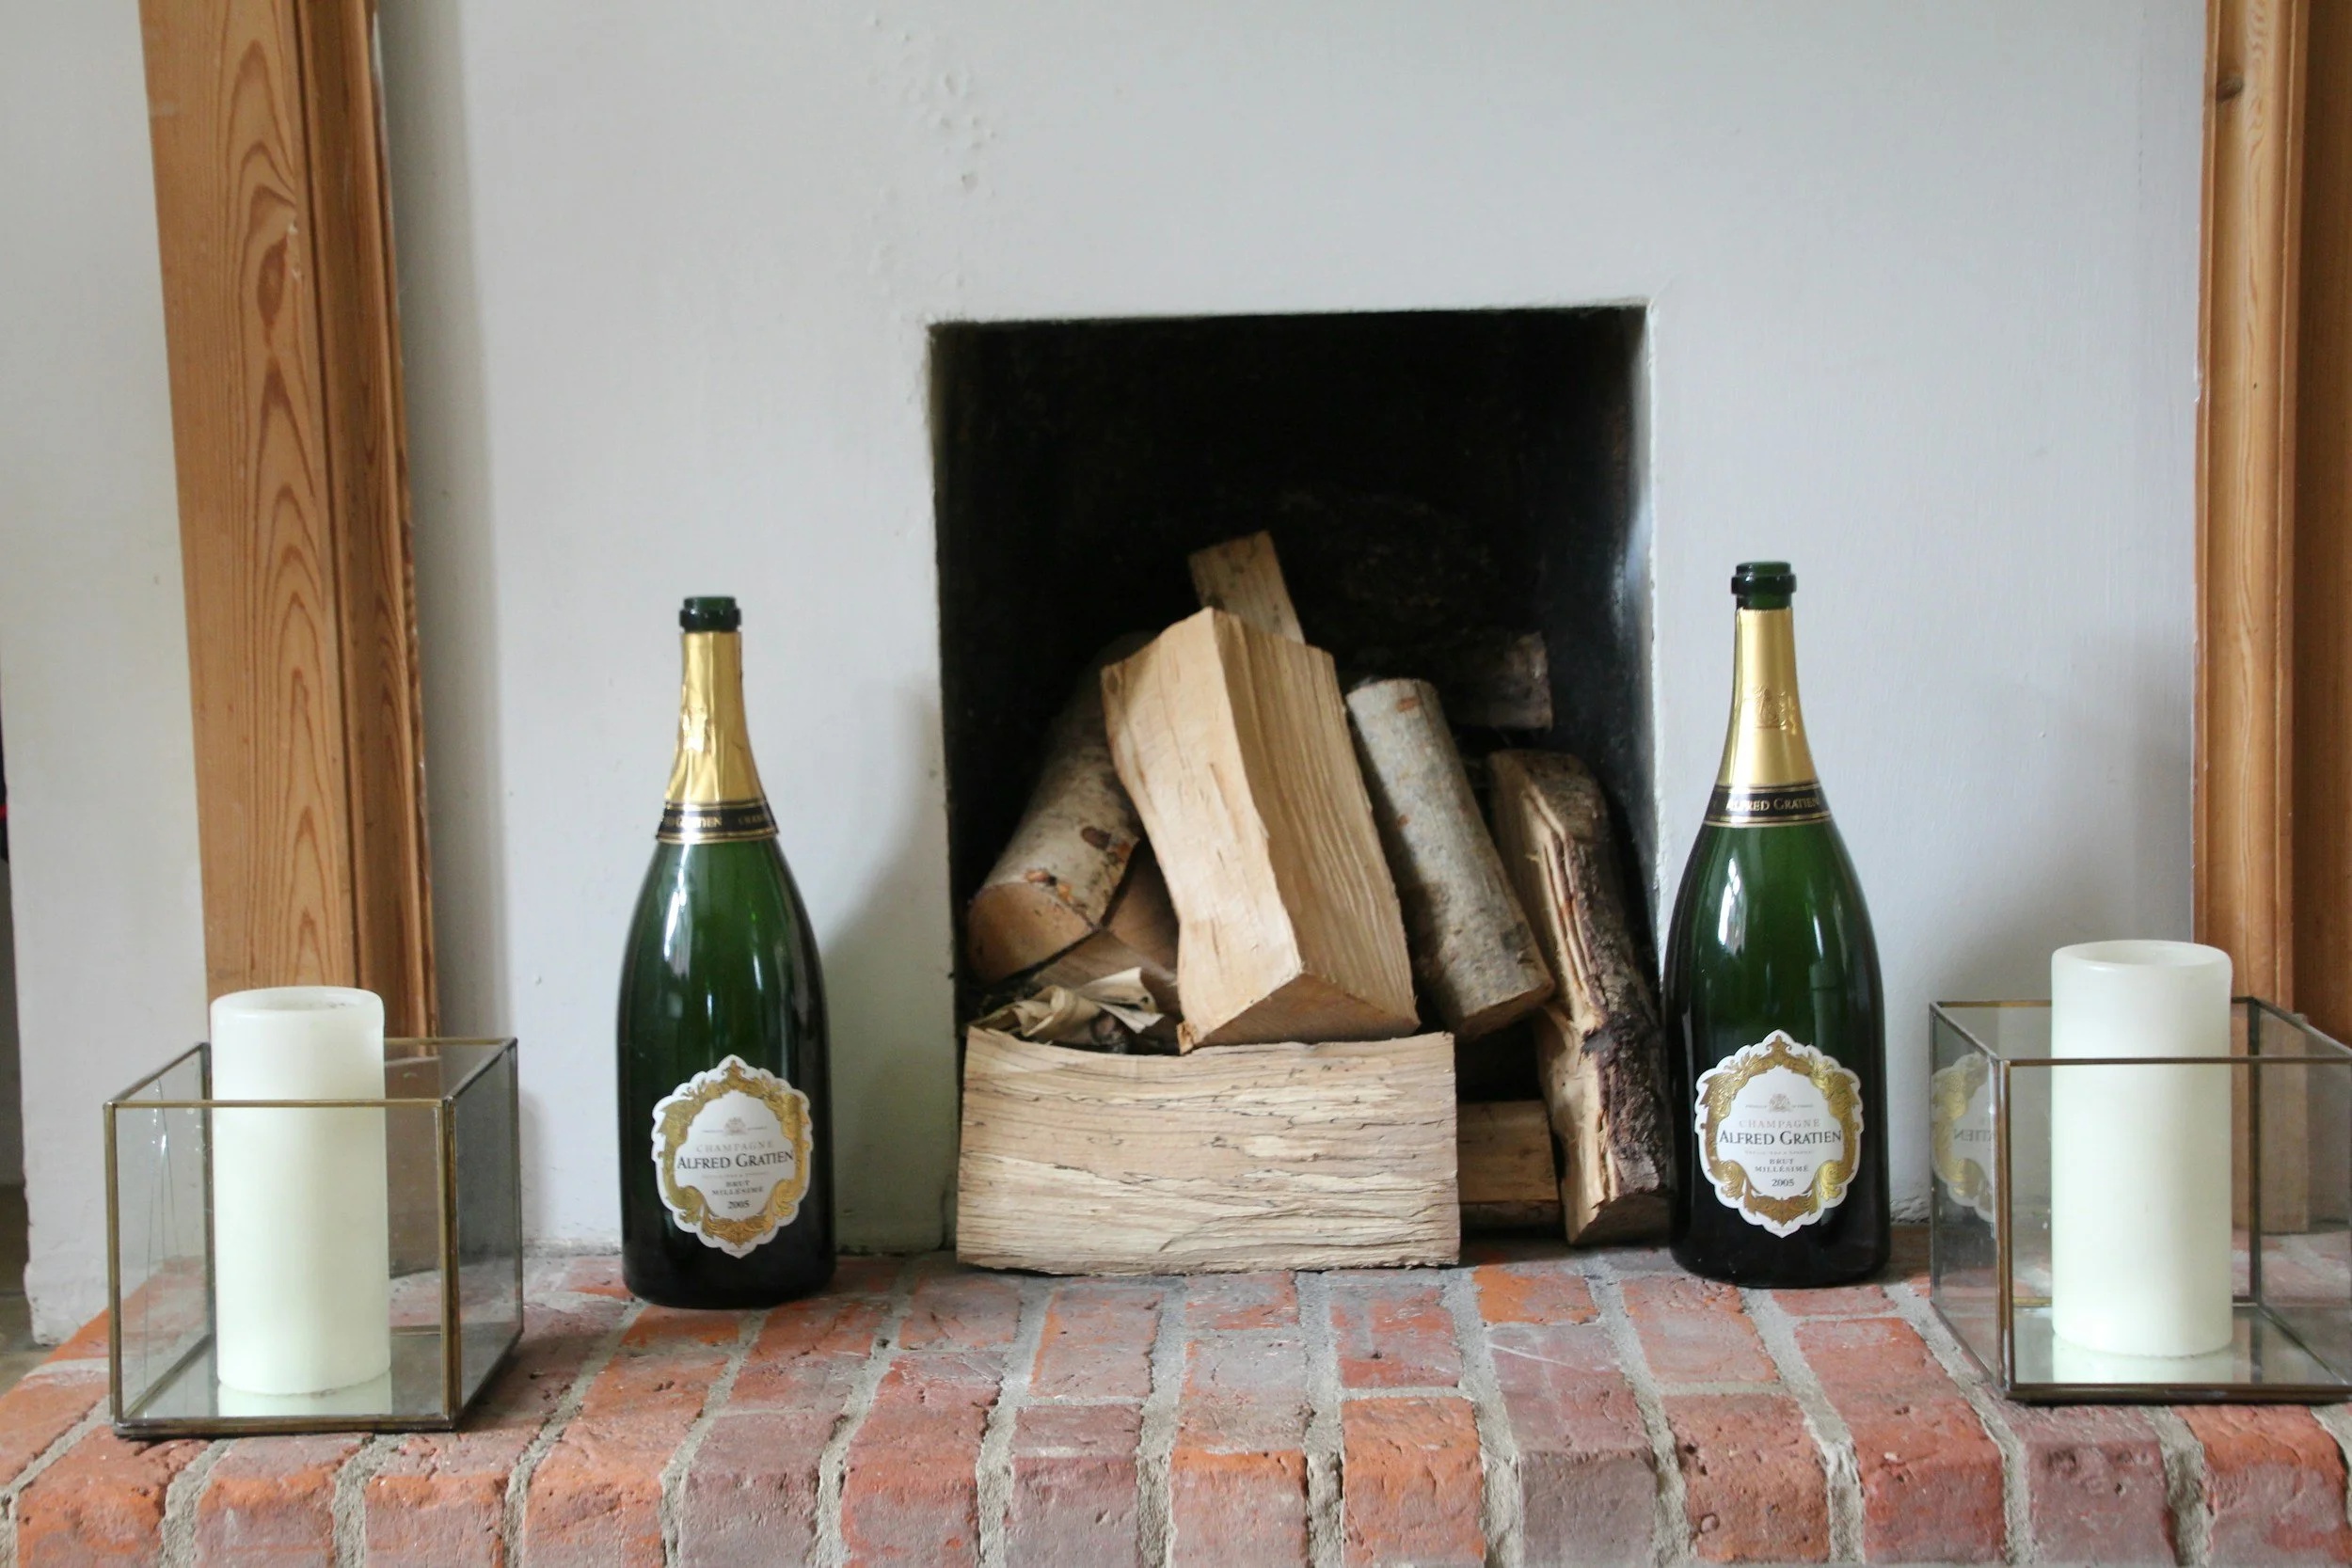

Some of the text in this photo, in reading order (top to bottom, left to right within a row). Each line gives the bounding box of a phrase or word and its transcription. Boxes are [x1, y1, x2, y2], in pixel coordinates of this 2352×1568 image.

[1739, 1117, 1820, 1129] CHAMPAGNE
[1719, 1130, 1841, 1146] ALFRED GRATIEN
[696, 1141, 773, 1152] CHAMPAGNE
[677, 1150, 794, 1169] ALFRED GRATIEN
[725, 1180, 750, 1188] BRUT
[1772, 1179, 1795, 1187] 2005
[727, 1199, 751, 1210] 2005
